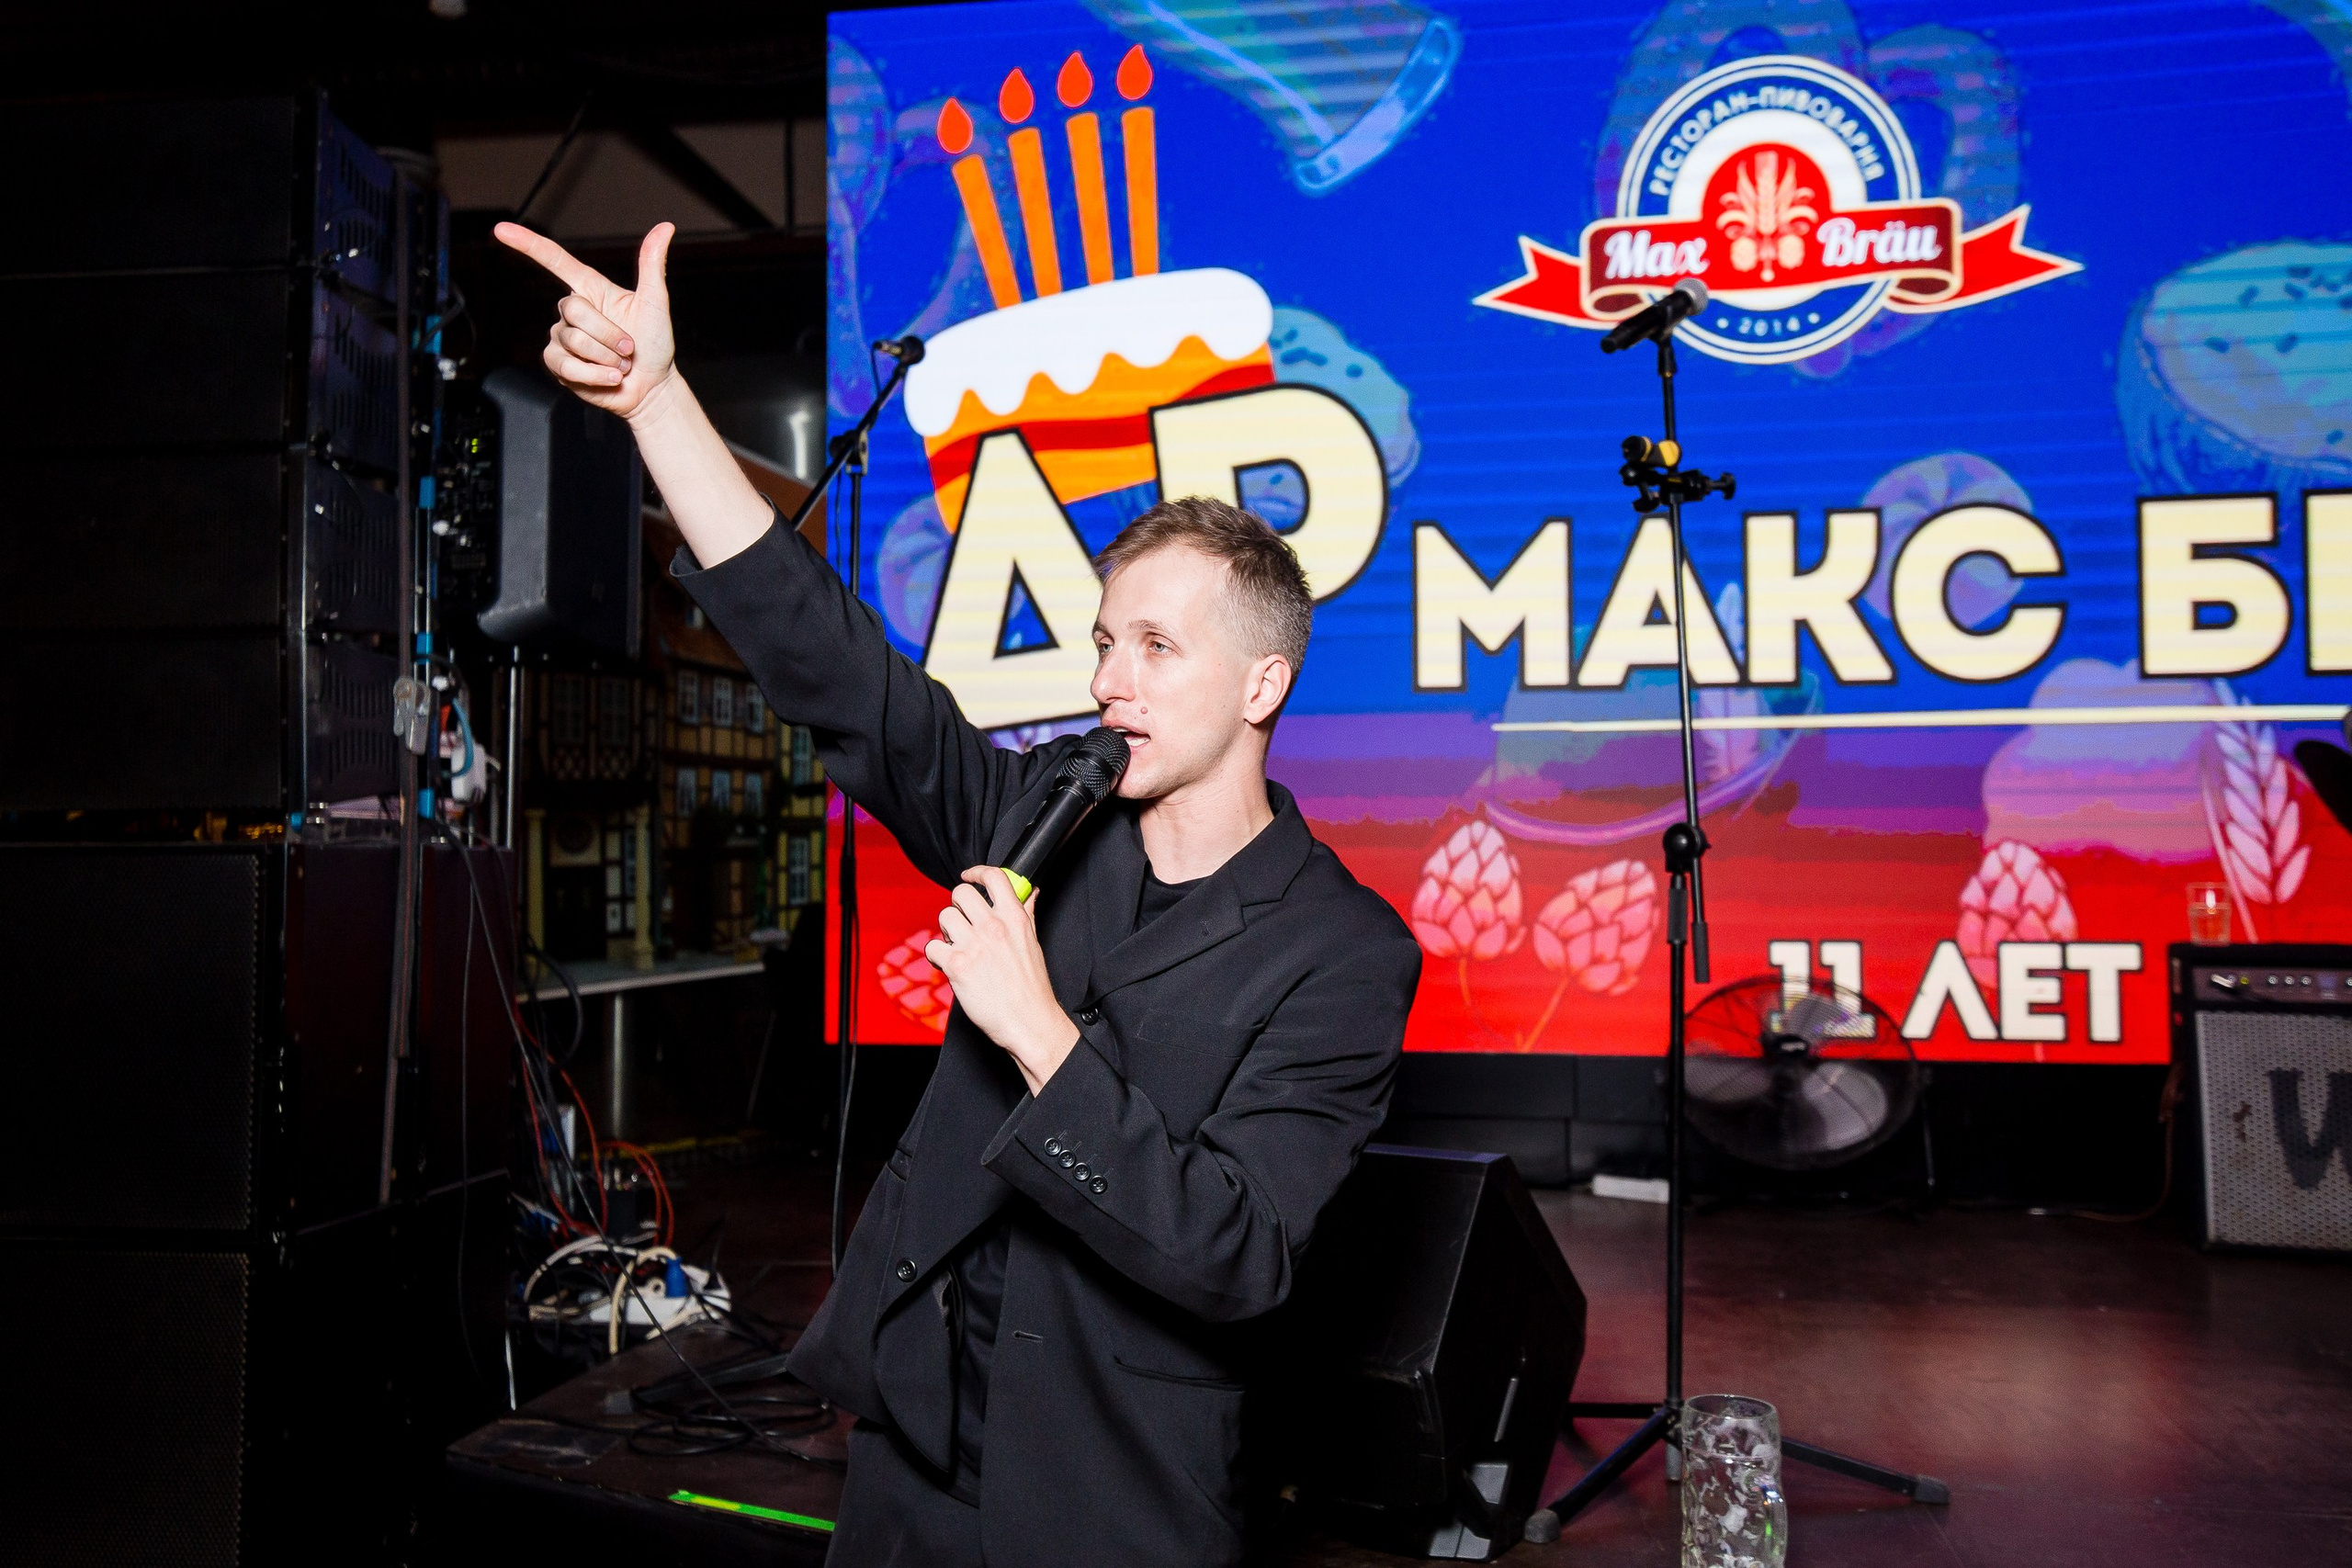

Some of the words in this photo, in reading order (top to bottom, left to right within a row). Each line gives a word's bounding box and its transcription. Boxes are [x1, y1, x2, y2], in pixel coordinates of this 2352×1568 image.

[1648, 85, 1885, 197] РЕСТОРАН-ПИВОВАРНЯ
[1603, 229, 1711, 279] Max
[1815, 217, 1942, 268] Bräu
[1737, 316, 1802, 337] 2014
[1412, 504, 2067, 691] МАКС
[1768, 939, 1877, 1040] 11
[1899, 939, 2144, 1043] ЛЕТ
